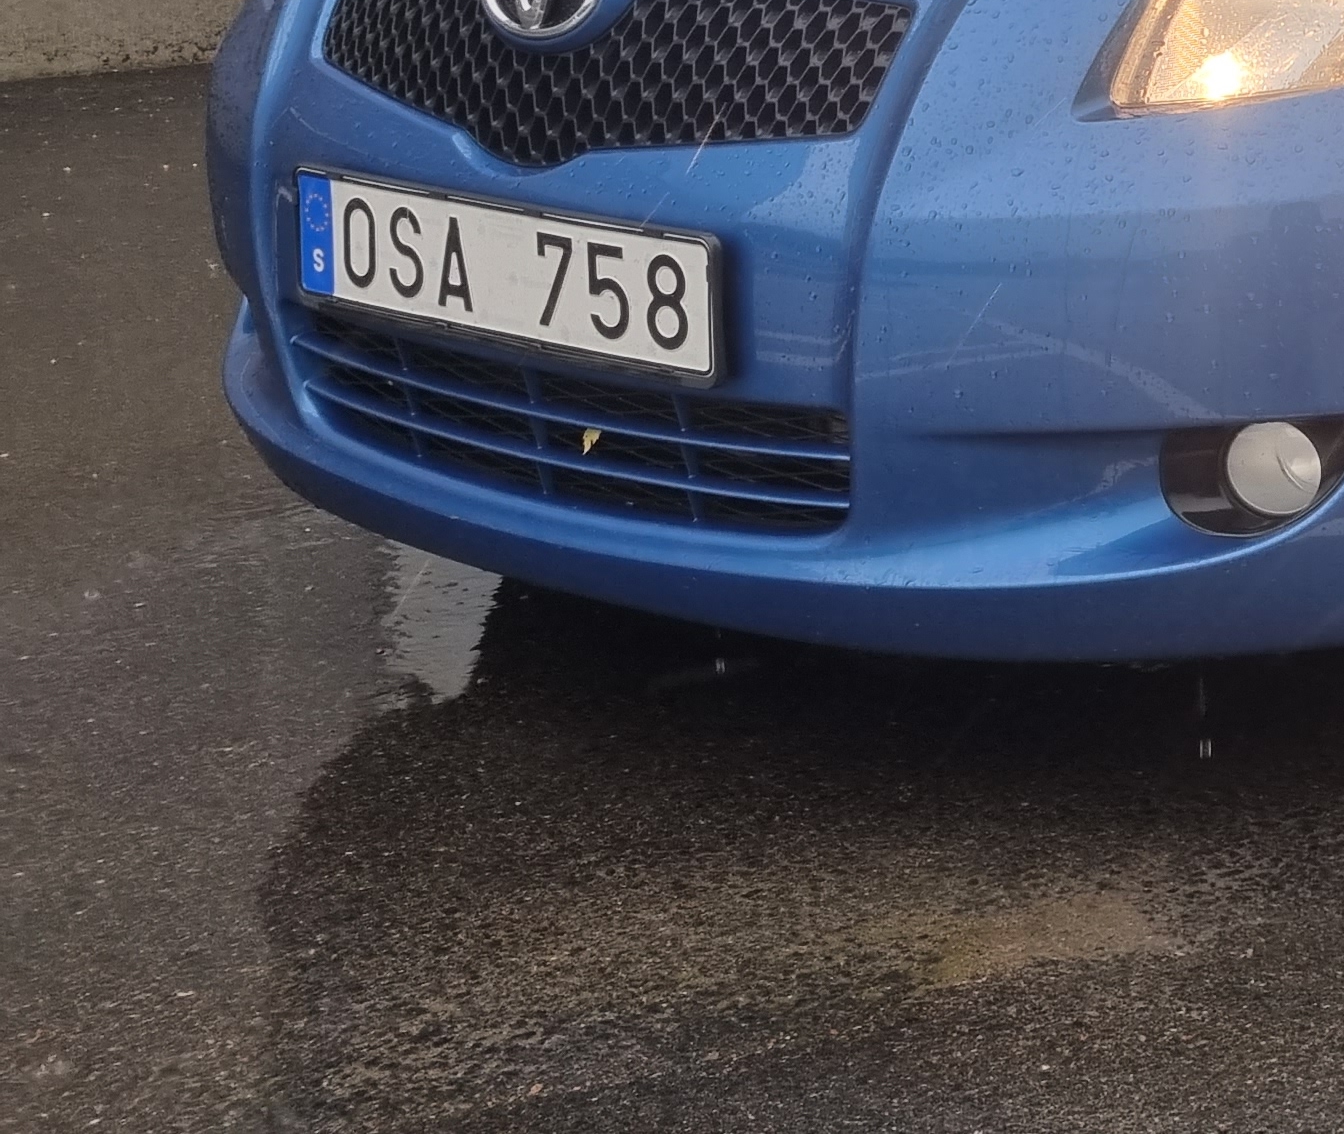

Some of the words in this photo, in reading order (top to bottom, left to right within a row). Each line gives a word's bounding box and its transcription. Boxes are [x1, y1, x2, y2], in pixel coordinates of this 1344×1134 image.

[312, 248, 325, 272] S
[342, 197, 474, 313] OSA
[536, 231, 689, 351] 758
